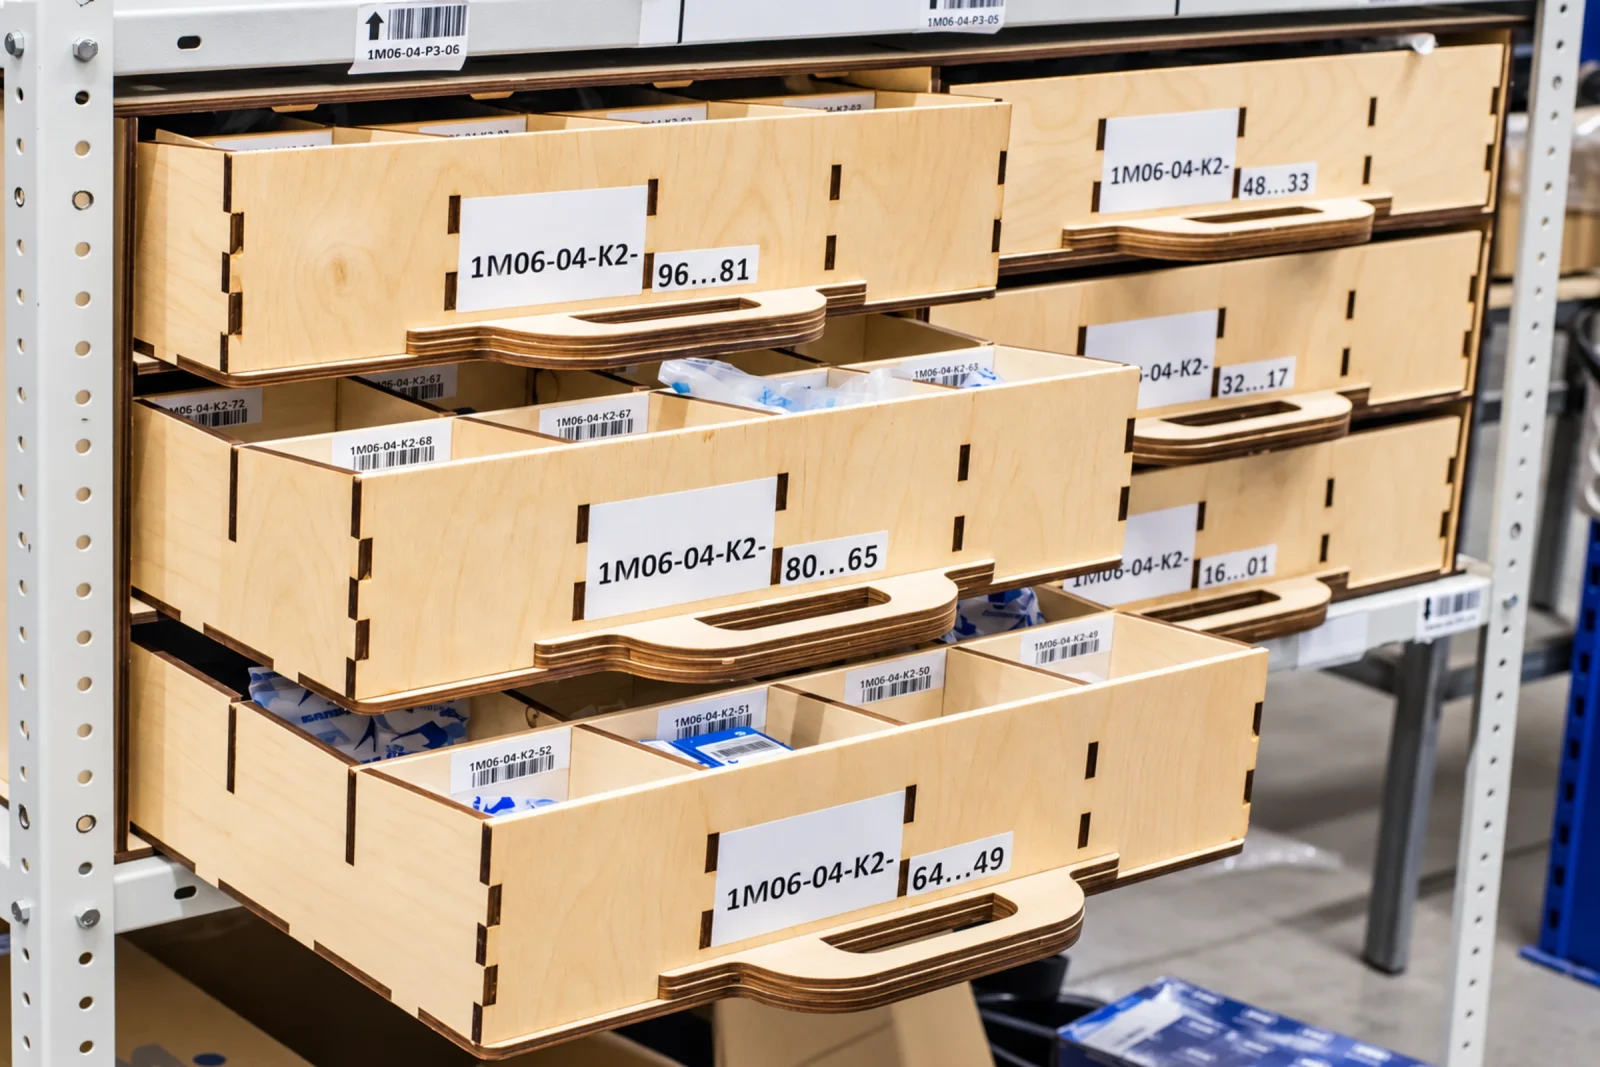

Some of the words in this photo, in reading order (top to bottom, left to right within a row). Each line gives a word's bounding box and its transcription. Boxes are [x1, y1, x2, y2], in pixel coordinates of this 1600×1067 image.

[928, 14, 999, 27] 1M06-04-P3-05
[368, 44, 460, 60] 1M06-04-P3-06
[1111, 157, 1230, 184] 1M06-04-K2-
[1243, 173, 1309, 196] 48...33
[471, 243, 638, 278] 1M06-04-K2-
[658, 258, 749, 288] 96...81
[1222, 368, 1288, 395] 32...17
[556, 409, 631, 428] 1M06-04-K2-67
[350, 436, 432, 455] 1M06-04-K2-68
[599, 537, 766, 585] 1M06-04-K2-
[785, 545, 878, 580] 80...65
[1203, 556, 1269, 586] 16...01
[1034, 631, 1098, 651] 1M06-04-K2-49
[860, 666, 930, 689] 1M06-04-K2-50
[674, 704, 749, 728] 1M06-04-K2-51
[469, 745, 552, 772] 1M06-04-K2-52
[727, 851, 894, 911] 1M06-04-K2-
[912, 846, 1004, 890] 64...49
